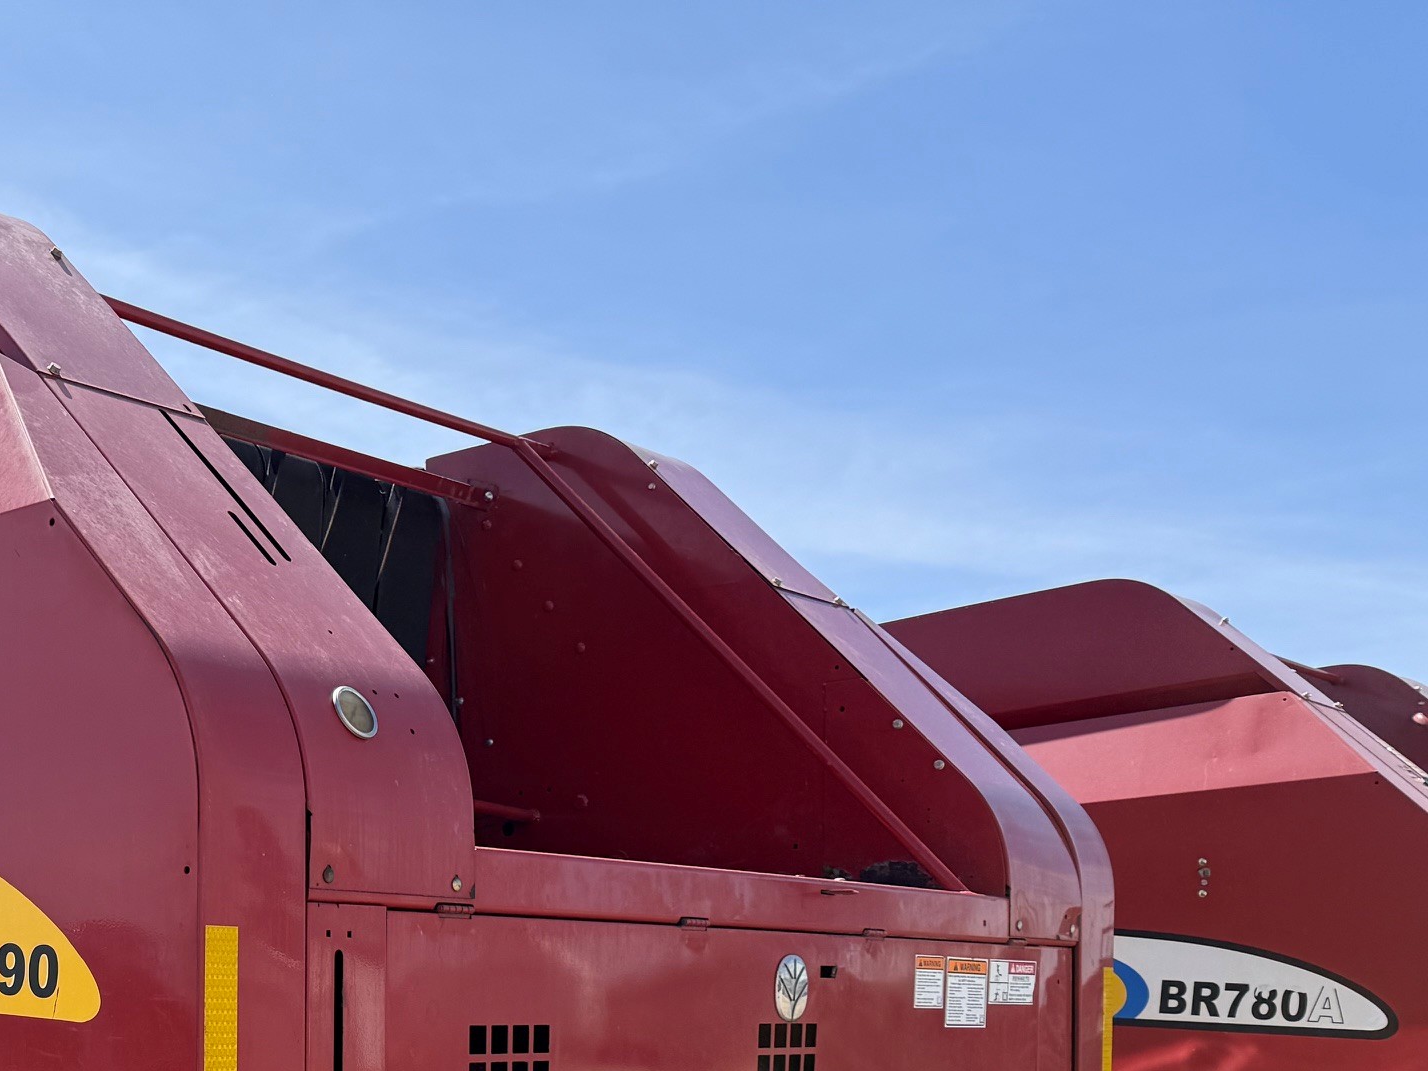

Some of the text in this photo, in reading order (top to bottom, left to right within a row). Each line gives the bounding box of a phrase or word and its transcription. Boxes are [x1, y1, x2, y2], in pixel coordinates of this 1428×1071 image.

[923, 960, 941, 968] WARNING
[960, 963, 981, 972] WARNING
[1015, 964, 1034, 974] DANGER
[1158, 979, 1344, 1025] BR780A
